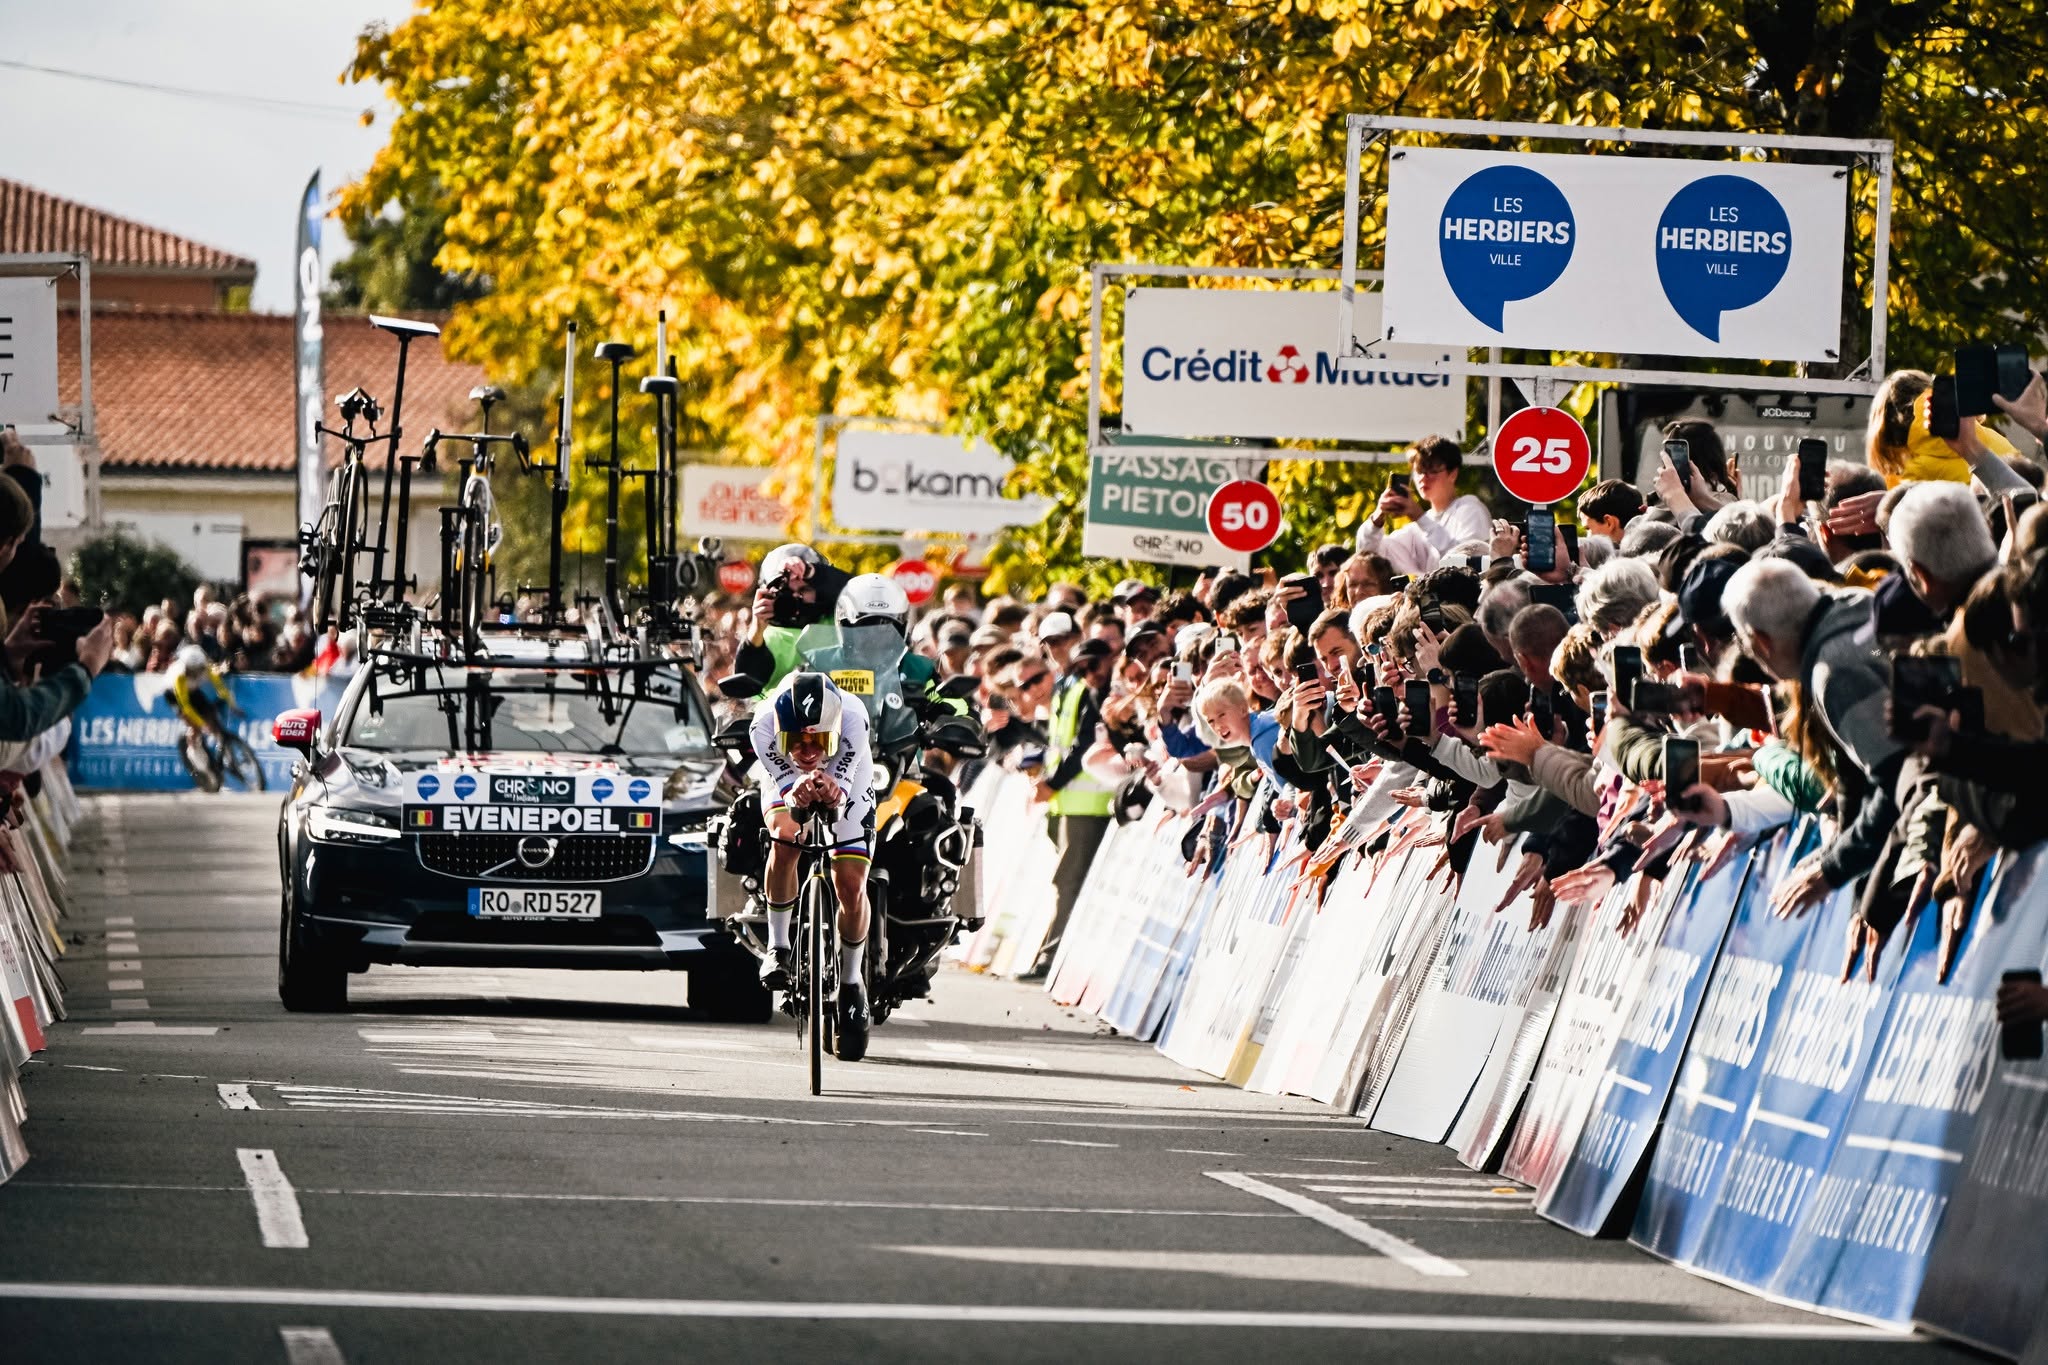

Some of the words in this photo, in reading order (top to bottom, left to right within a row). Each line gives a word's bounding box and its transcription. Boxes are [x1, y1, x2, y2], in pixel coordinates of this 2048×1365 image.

[1494, 197, 1523, 214] LES
[1709, 206, 1739, 223] LES
[1444, 217, 1571, 246] HERBIERS
[1660, 227, 1787, 256] HERBIERS
[1489, 252, 1522, 267] VILLE
[1705, 262, 1739, 277] VILLE
[1141, 347, 1262, 383] Crédit
[1762, 407, 1812, 418] JCDecaux
[1725, 435, 1846, 451] NOUVU
[1511, 436, 1571, 475] 25
[1101, 455, 1233, 484] PASSAG
[1221, 501, 1269, 531] 50
[279, 729, 306, 738] EDER
[281, 720, 308, 730] AUTO
[765, 752, 791, 772] BOSS
[836, 751, 856, 774] BOSS
[494, 778, 570, 795] CHRONO
[443, 805, 620, 832] EVENEPOEL
[481, 891, 510, 913] RO
[523, 892, 551, 914] RD
[556, 893, 597, 914] 527
